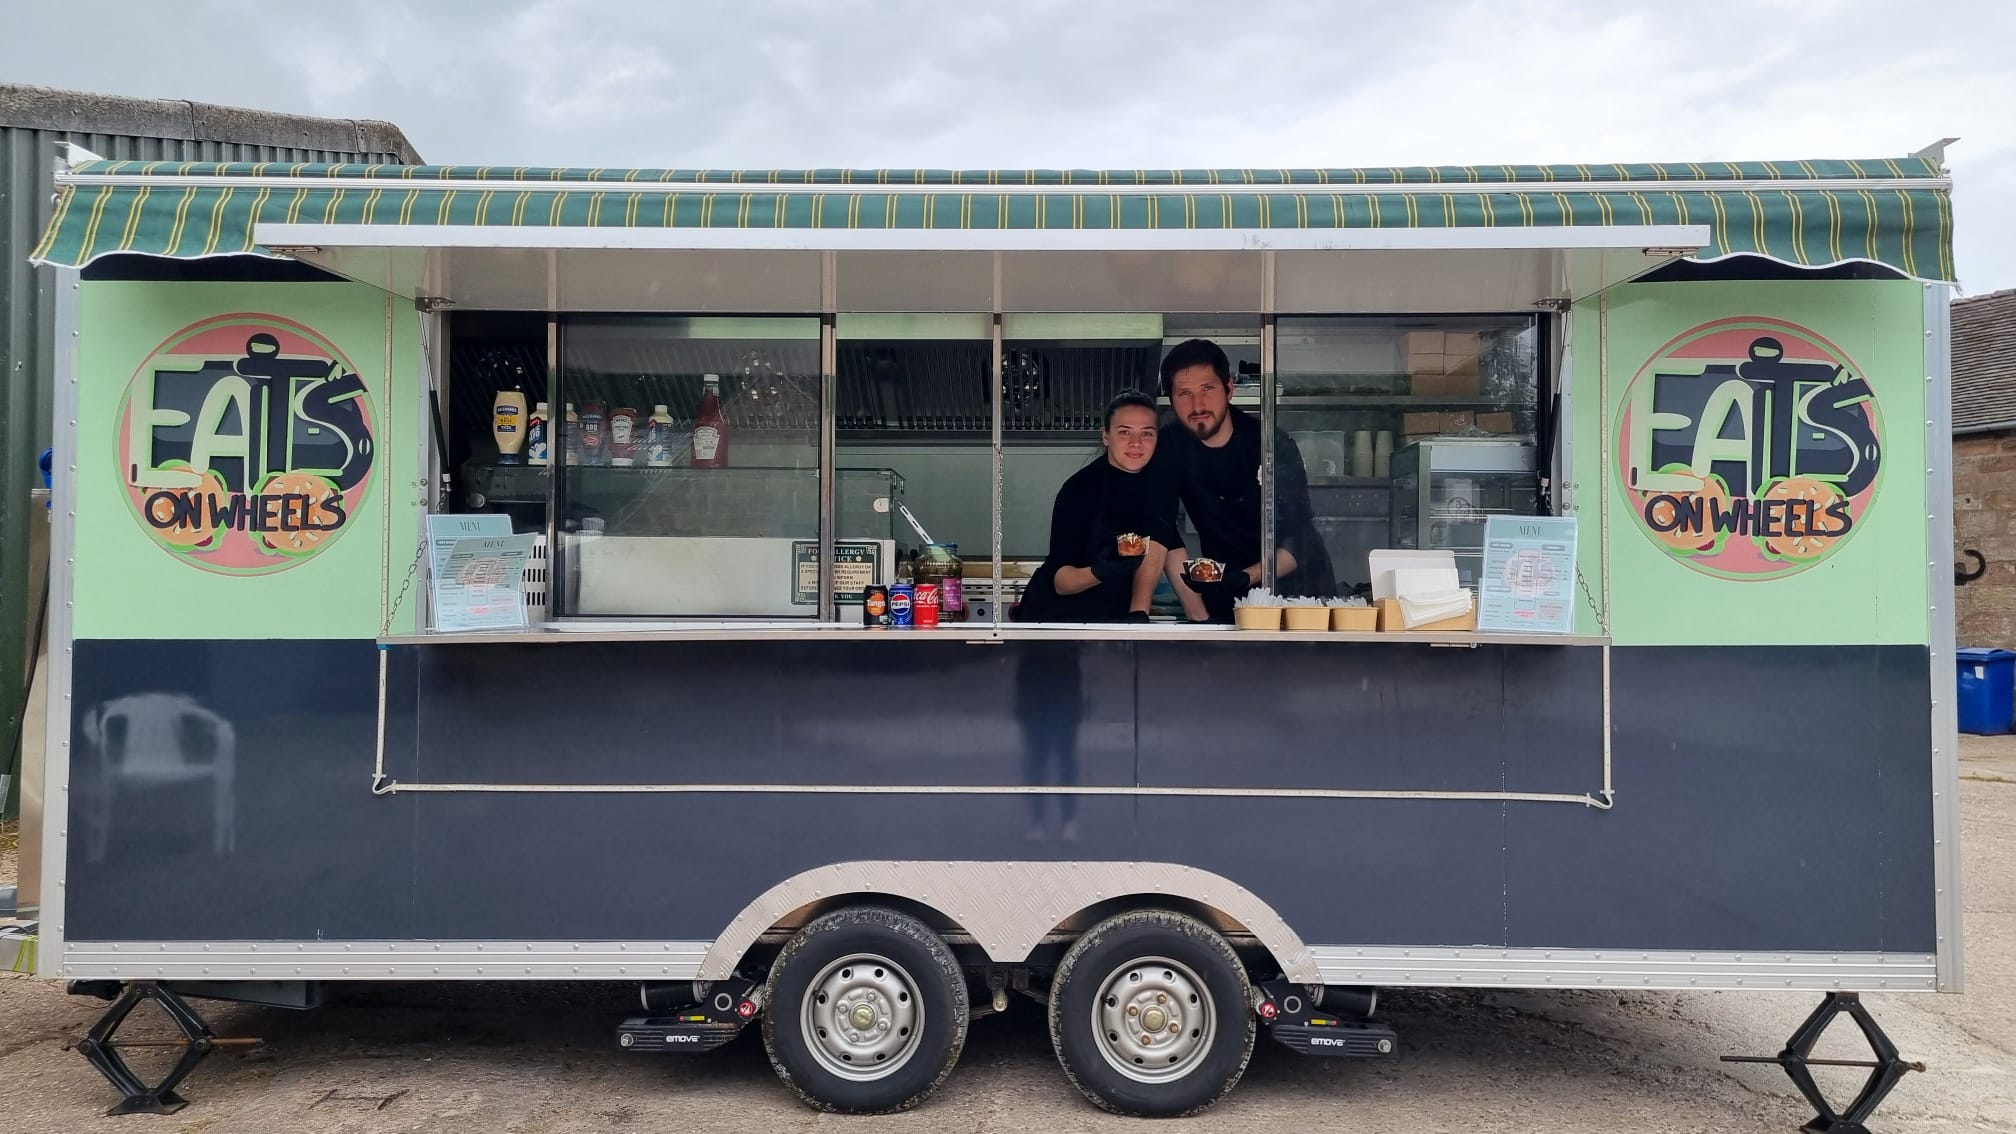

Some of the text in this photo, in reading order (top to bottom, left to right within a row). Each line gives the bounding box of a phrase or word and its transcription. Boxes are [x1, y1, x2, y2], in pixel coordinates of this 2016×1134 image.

[129, 354, 374, 493] EATS
[1629, 358, 1881, 498] EATS
[145, 491, 347, 532] ON WHEELS
[1519, 525, 1542, 537] MENU
[1645, 494, 1853, 537] ON WHEELS
[834, 548, 866, 556] LLERGY
